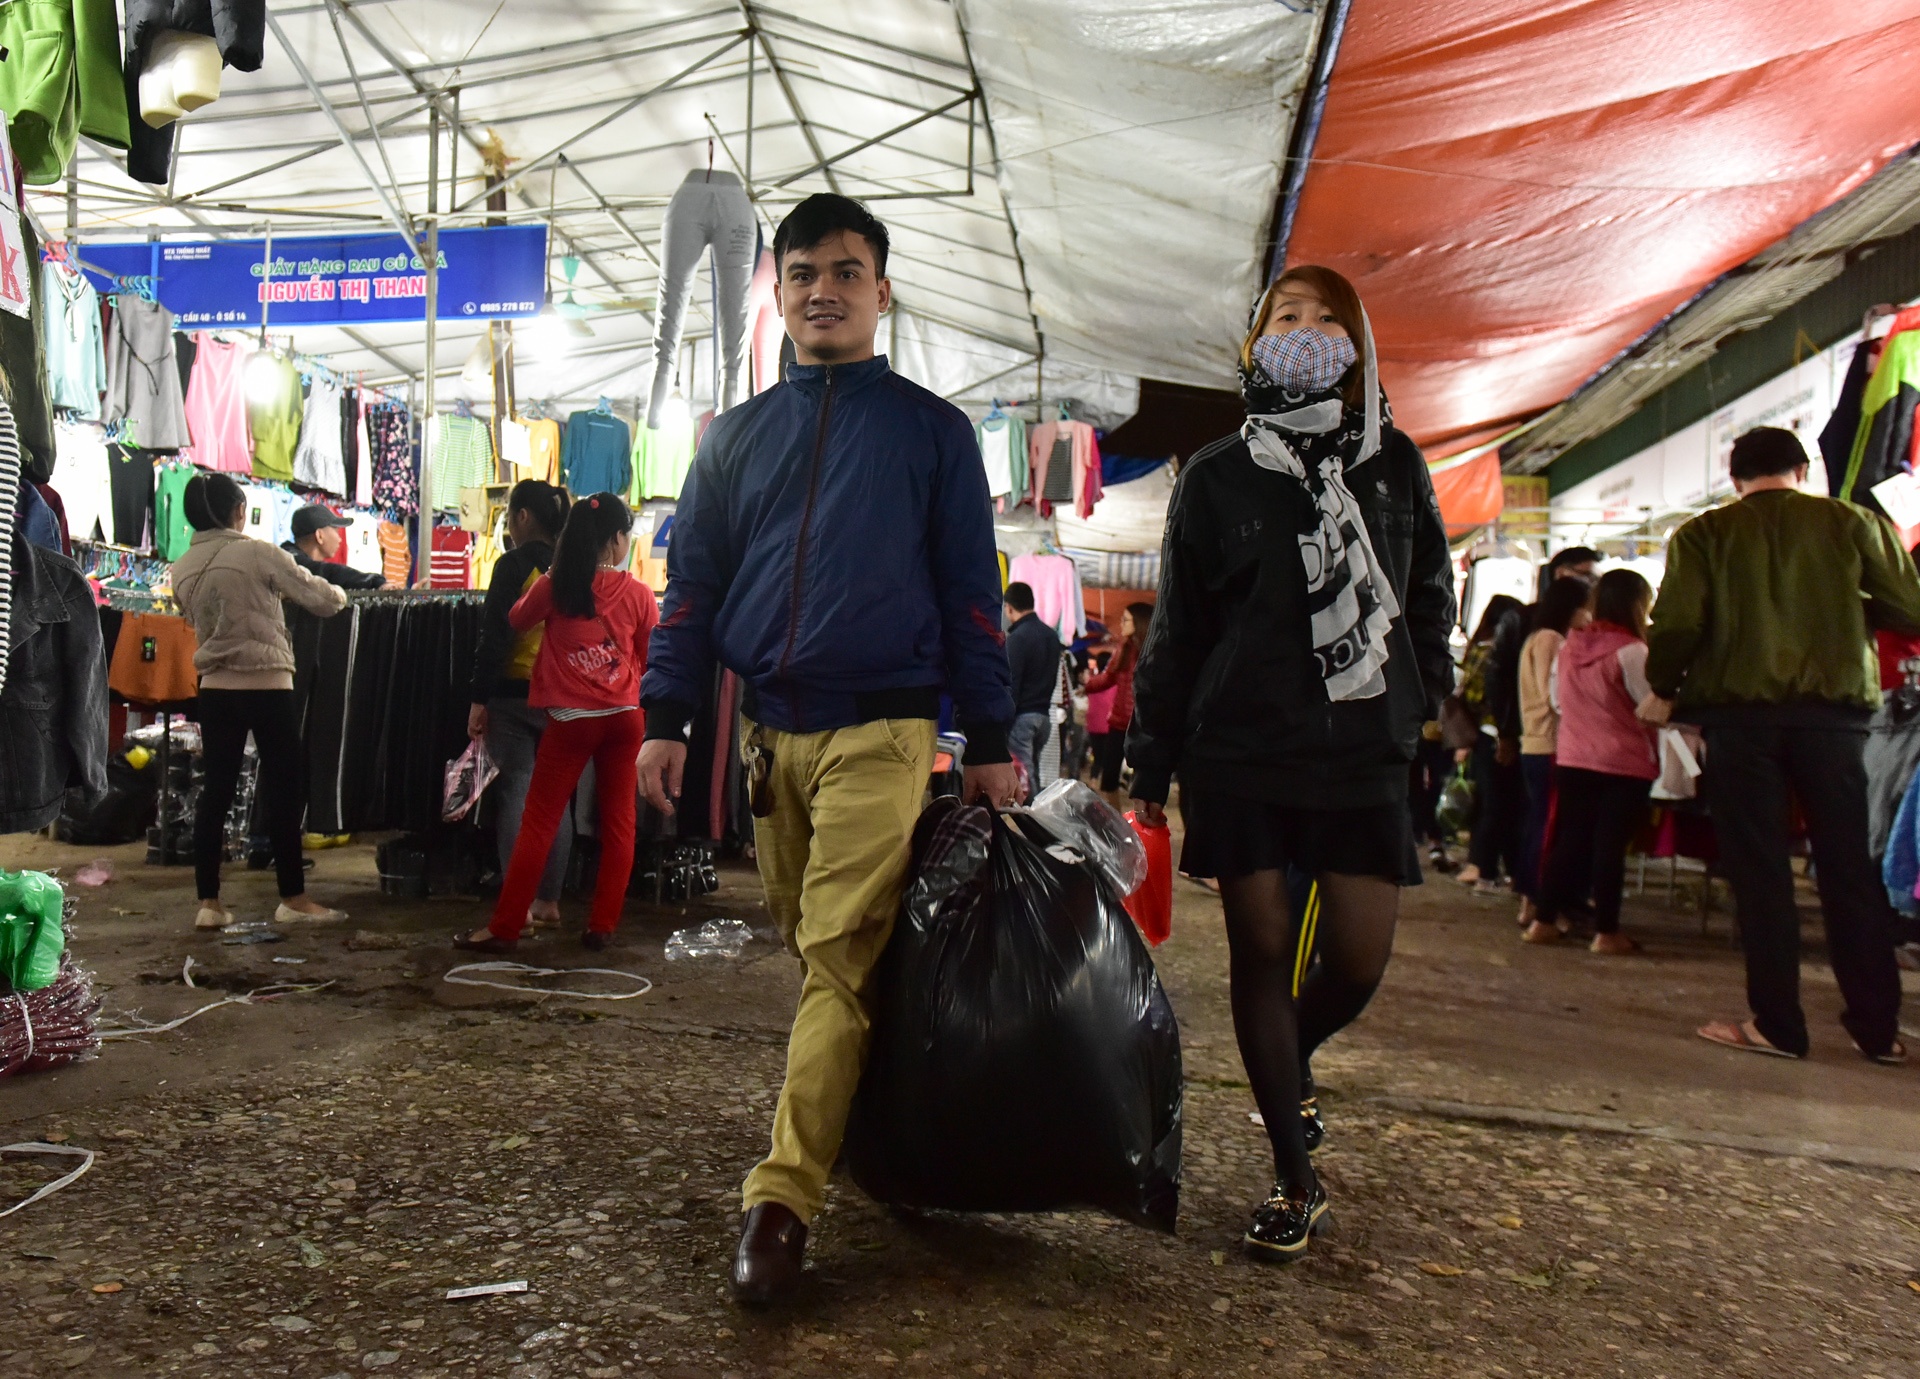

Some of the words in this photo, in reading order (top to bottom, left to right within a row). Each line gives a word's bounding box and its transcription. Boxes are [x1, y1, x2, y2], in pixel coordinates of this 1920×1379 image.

[298, 257, 346, 275] HÀNG
[348, 258, 381, 273] RAU
[382, 252, 408, 272] CỦ
[258, 273, 336, 303] NGUYỄN
[338, 278, 370, 304] THỊ
[223, 309, 235, 322] SỐ
